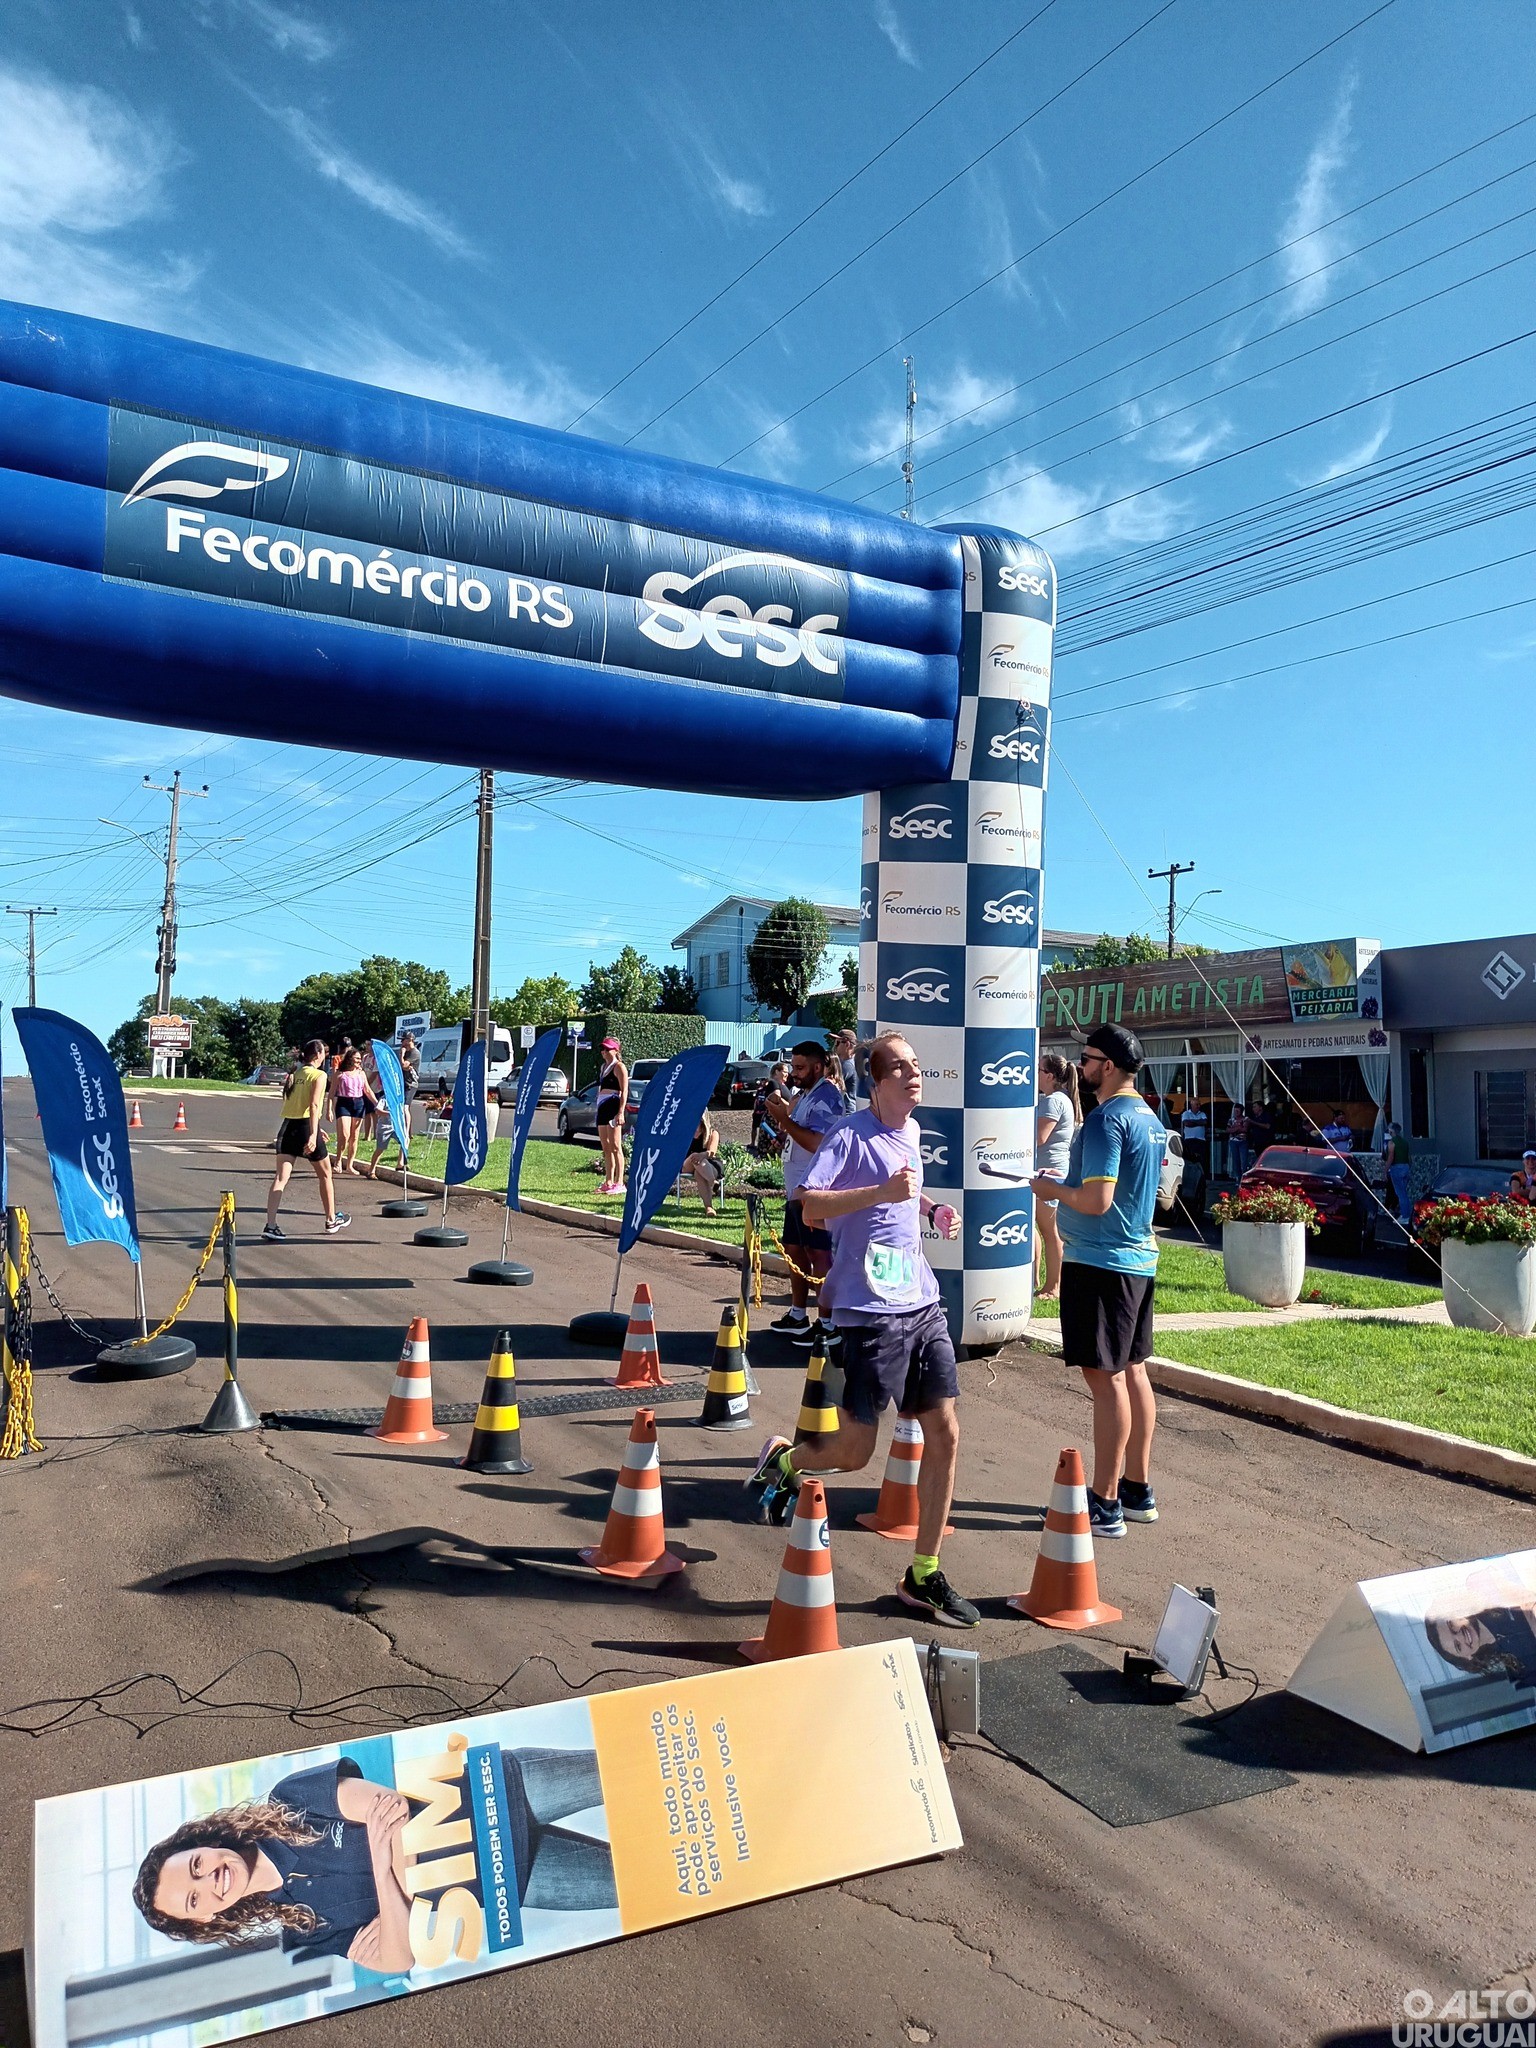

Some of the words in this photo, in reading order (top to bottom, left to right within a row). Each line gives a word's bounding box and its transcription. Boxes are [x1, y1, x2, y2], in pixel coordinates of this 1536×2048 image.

[166, 507, 492, 612] Fecomércio
[507, 577, 574, 629] RS
[997, 562, 1049, 600] Sesc
[637, 560, 841, 675] Sesc
[993, 657, 1042, 675] Fecomércio
[987, 729, 1040, 763] Sesc
[888, 809, 953, 840] Sesc
[981, 825, 1032, 839] Fecomércio
[885, 903, 942, 915] Fecomércio
[945, 906, 961, 916] RS
[982, 895, 1034, 926] Sesc
[886, 973, 950, 1003] Sesc
[978, 986, 1028, 1000] Fecomércio
[1039, 982, 1124, 1028] FRUTI
[1133, 975, 1265, 1013] AMETISTA
[1292, 986, 1356, 1001] MERCEARIA
[1300, 1001, 1354, 1015] PEIXARIA
[1263, 1039, 1301, 1049] ARTESANATO
[1302, 1038, 1307, 1048] E
[1308, 1036, 1333, 1047] PEDRAS
[1334, 1034, 1366, 1046] NATURAIS
[69, 1042, 95, 1122] Fecomércio
[943, 1069, 959, 1080] RS
[979, 1057, 1031, 1086] Sesc
[91, 1075, 108, 1118] Senac
[650, 1063, 684, 1136] Fecomércio
[660, 1097, 682, 1137] Senac
[88, 1132, 125, 1220] Sesc
[976, 1150, 1025, 1162] Fecomércio
[979, 1216, 1029, 1247] Sesc
[976, 1308, 1024, 1322] Fecomércio
[666, 1704, 679, 1726] os
[683, 1709, 700, 1760] Sesc.
[651, 1710, 673, 1779] mundo
[712, 1716, 732, 1768] você.
[904, 1721, 919, 1766] Sindicatos
[479, 1751, 495, 1794] SESC.
[671, 1733, 699, 1835] aproveitar
[692, 1766, 706, 1792] do
[916, 1777, 925, 1791] RS
[484, 1796, 499, 1827] SER
[664, 1786, 682, 1835] todo
[725, 1774, 750, 1861] Inclusive
[921, 1792, 938, 1844] Fecomércio
[487, 1827, 505, 1885] PODEM
[699, 1798, 723, 1882] serviços
[671, 1840, 692, 1894] Aqui,
[688, 1841, 712, 1896] pode
[495, 1886, 512, 1944] TODOS
